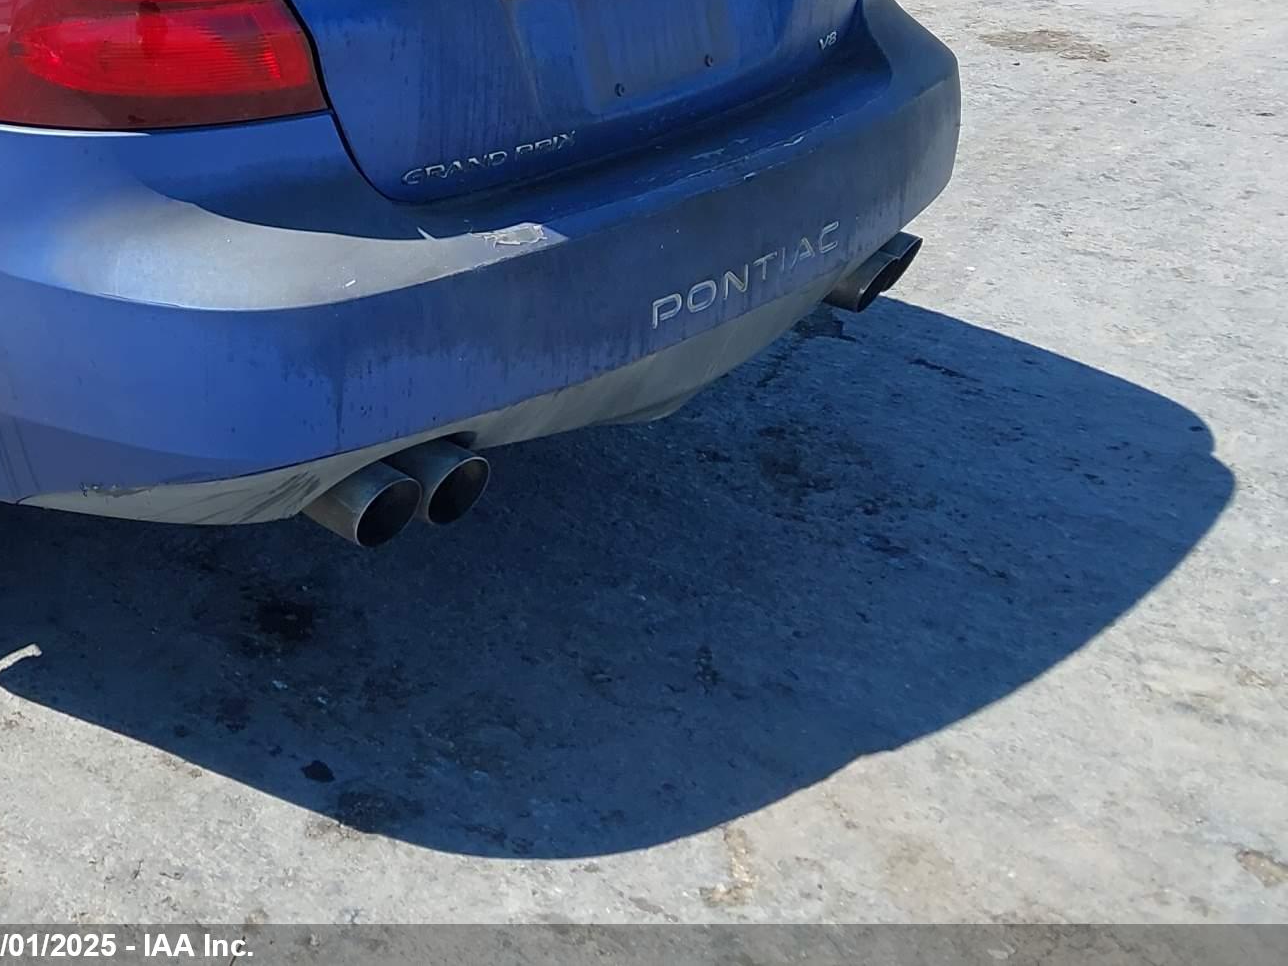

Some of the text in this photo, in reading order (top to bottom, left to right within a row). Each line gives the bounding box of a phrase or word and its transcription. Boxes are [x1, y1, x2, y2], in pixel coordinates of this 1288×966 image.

[401, 130, 576, 185] GRAND PRIX
[651, 220, 840, 330] PONTIAC
